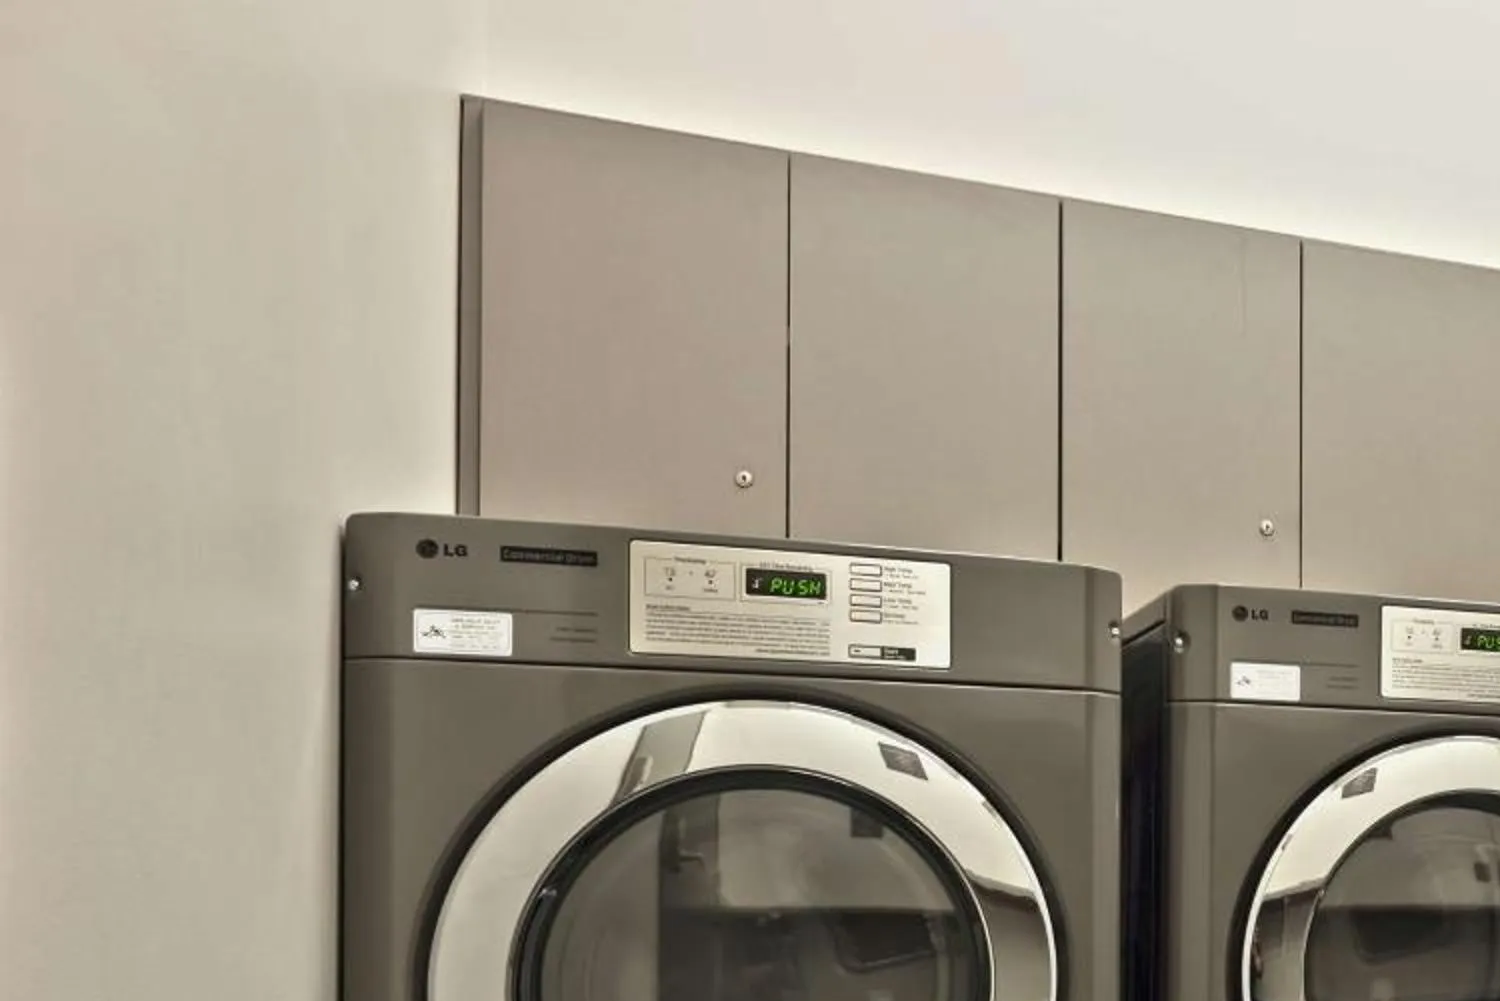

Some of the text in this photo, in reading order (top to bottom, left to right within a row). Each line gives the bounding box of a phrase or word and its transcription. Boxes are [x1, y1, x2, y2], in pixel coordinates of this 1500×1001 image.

[443, 543, 468, 558] LG
[768, 576, 821, 596] PUSH
[1250, 609, 1269, 621] LG
